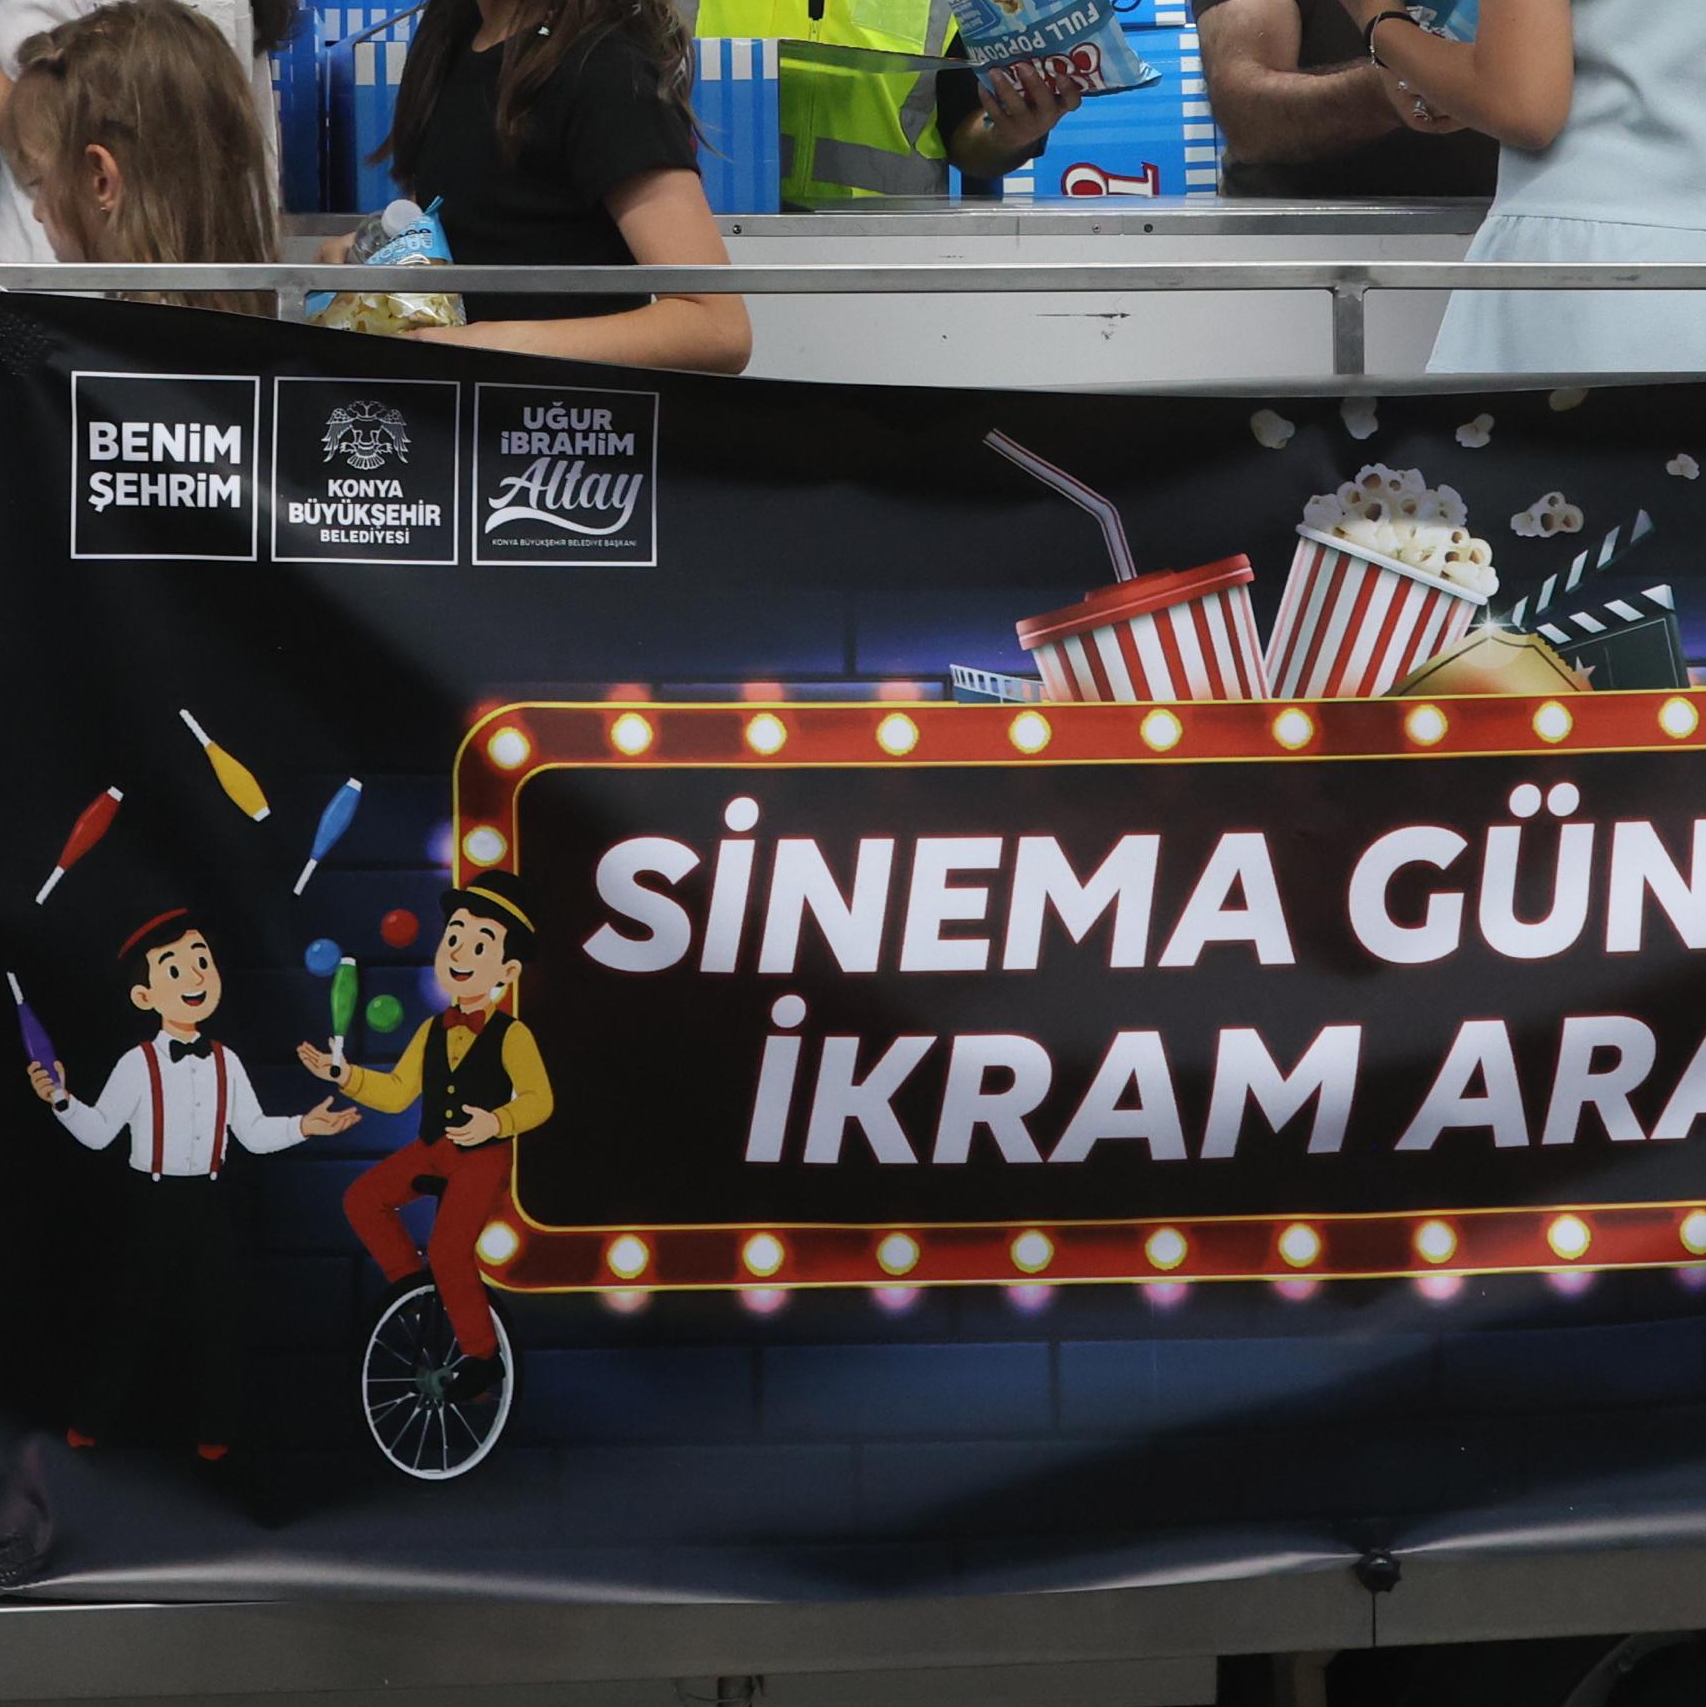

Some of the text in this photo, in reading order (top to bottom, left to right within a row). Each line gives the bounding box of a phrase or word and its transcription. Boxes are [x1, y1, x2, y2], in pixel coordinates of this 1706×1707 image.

[1044, 0, 1101, 41] FULL
[522, 401, 613, 431] UĞUR
[327, 478, 404, 498] KONYA
[484, 456, 644, 536] Altay
[288, 497, 442, 529] BÜYÜKŞEHİR
[320, 527, 411, 545] BELEDİYESİ
[581, 796, 1297, 974] SİNEMA
[744, 993, 1363, 1164] İKRAM
